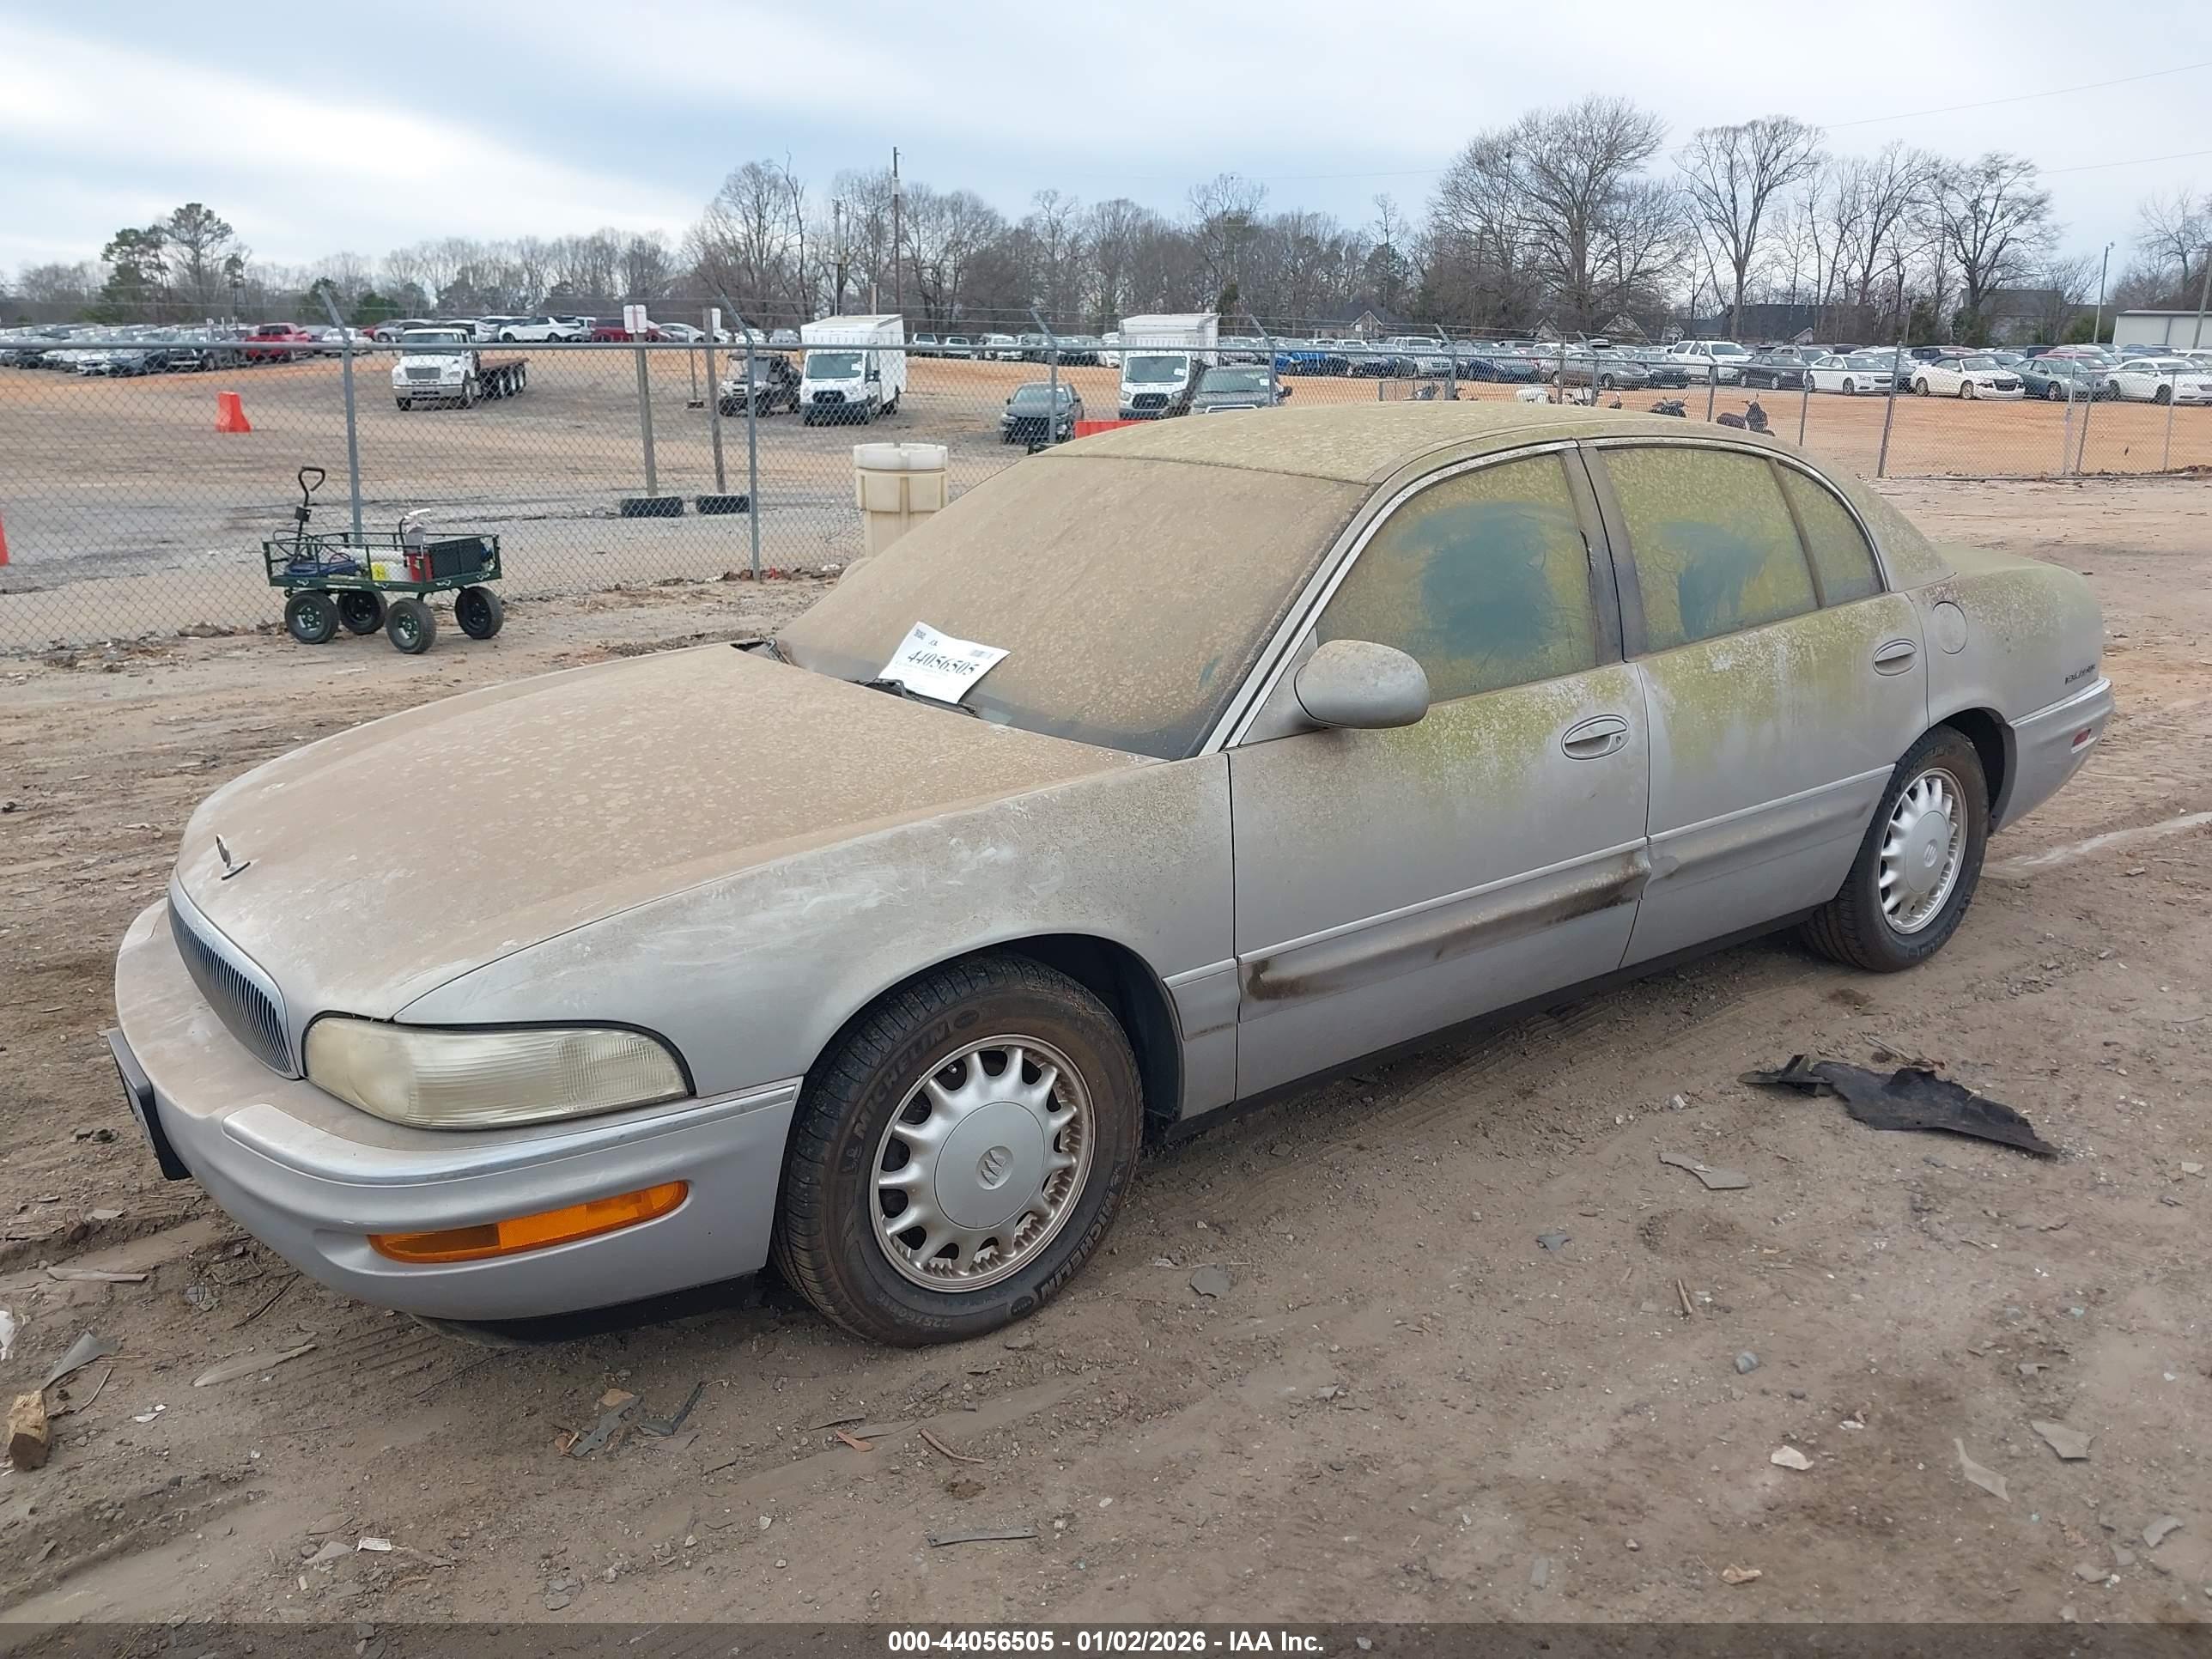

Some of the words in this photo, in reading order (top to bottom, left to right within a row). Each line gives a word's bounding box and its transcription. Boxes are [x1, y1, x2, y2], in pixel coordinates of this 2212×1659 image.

[908, 650, 980, 675] 44056505
[853, 1016, 953, 1139] MICHELIN
[1040, 1189, 1118, 1301] MICHELIN
